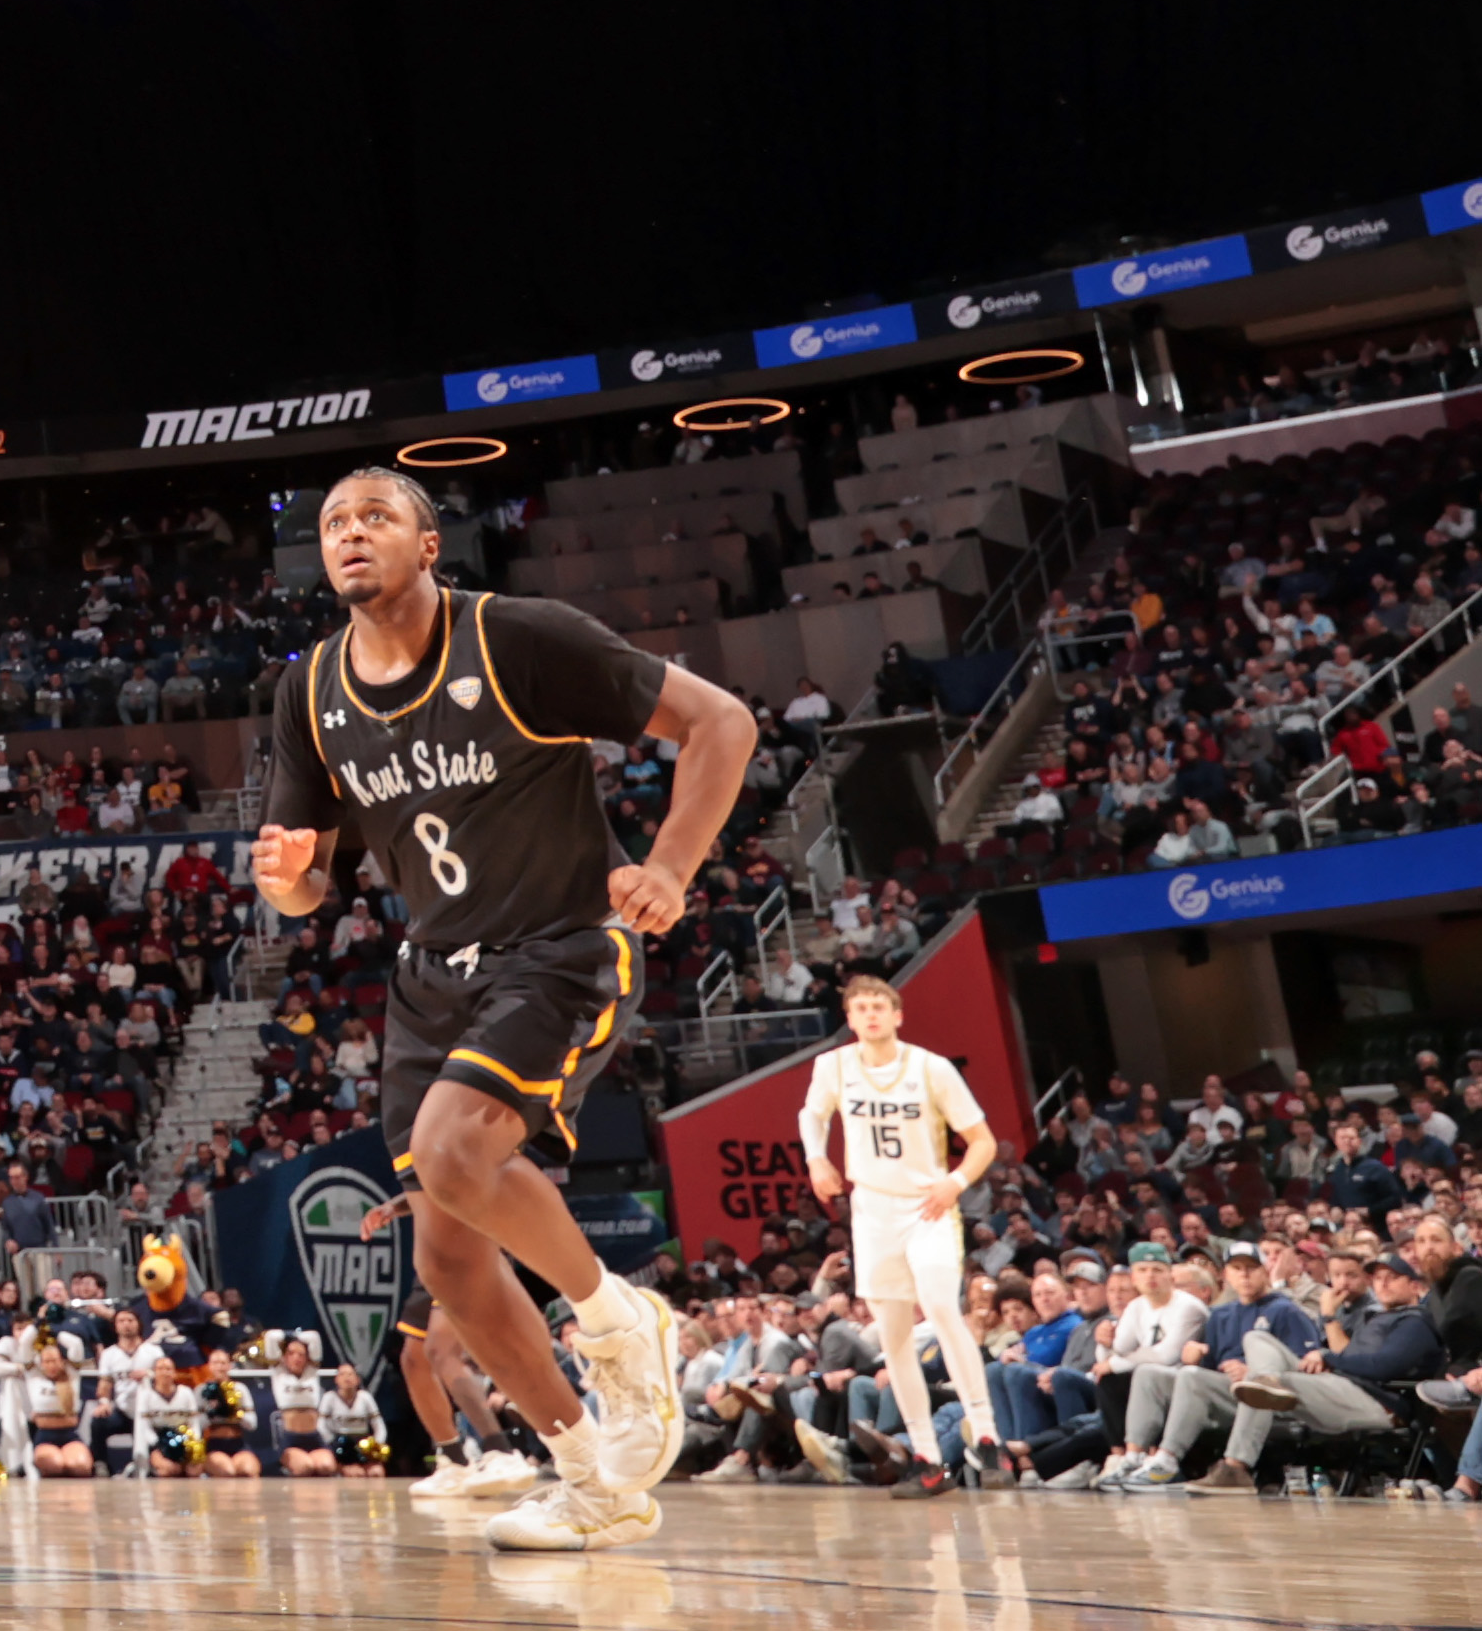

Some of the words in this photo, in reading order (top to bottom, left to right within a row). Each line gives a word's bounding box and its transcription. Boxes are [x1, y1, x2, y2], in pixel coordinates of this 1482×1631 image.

[1324, 217, 1390, 246] Genius
[1147, 254, 1210, 283] Genius
[981, 289, 1041, 315] Genius
[822, 320, 880, 346] Genius
[664, 346, 722, 370] Genius
[507, 370, 565, 394] Genius
[140, 389, 371, 448] MACTION
[340, 751, 412, 808] Kent
[412, 740, 498, 791] State
[413, 813, 468, 896] 8
[1210, 873, 1285, 903] Genius
[848, 1100, 921, 1119] ZIPS
[871, 1125, 903, 1159] 15
[311, 1245, 396, 1297] MAC
